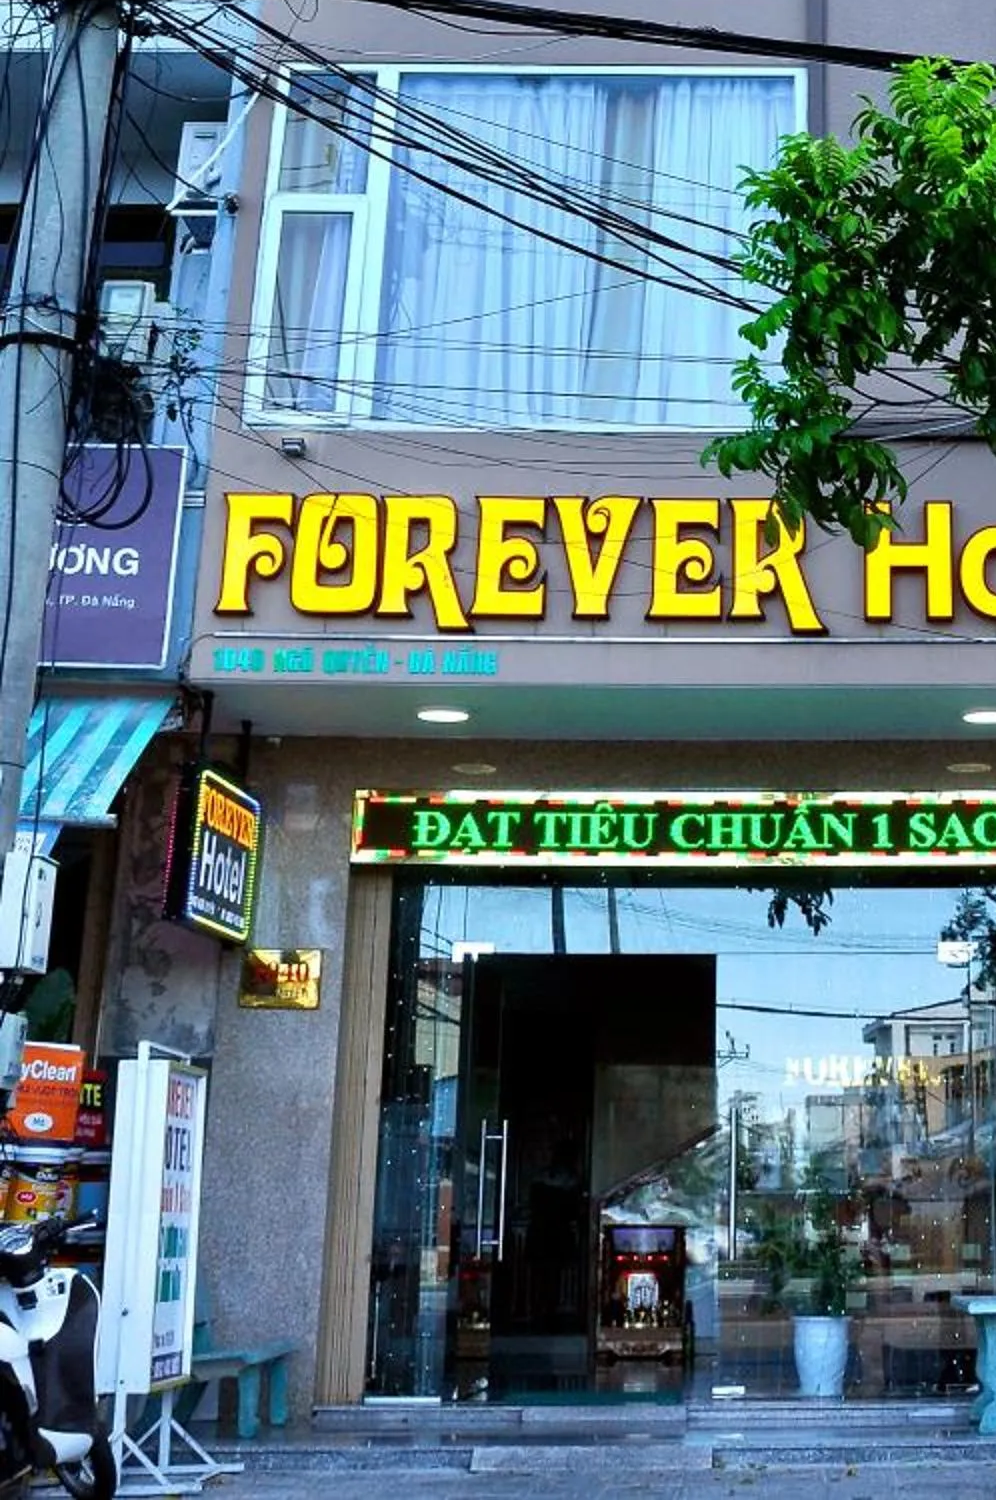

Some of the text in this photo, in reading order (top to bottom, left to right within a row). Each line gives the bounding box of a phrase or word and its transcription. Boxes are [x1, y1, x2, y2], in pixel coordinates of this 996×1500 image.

[214, 492, 829, 635] FOREVER
[412, 811, 521, 853] ĐẠT
[533, 803, 659, 849] TIÊU
[872, 813, 894, 848] 1
[200, 829, 246, 905] Hotel
[164, 1125, 192, 1172] OTEL
